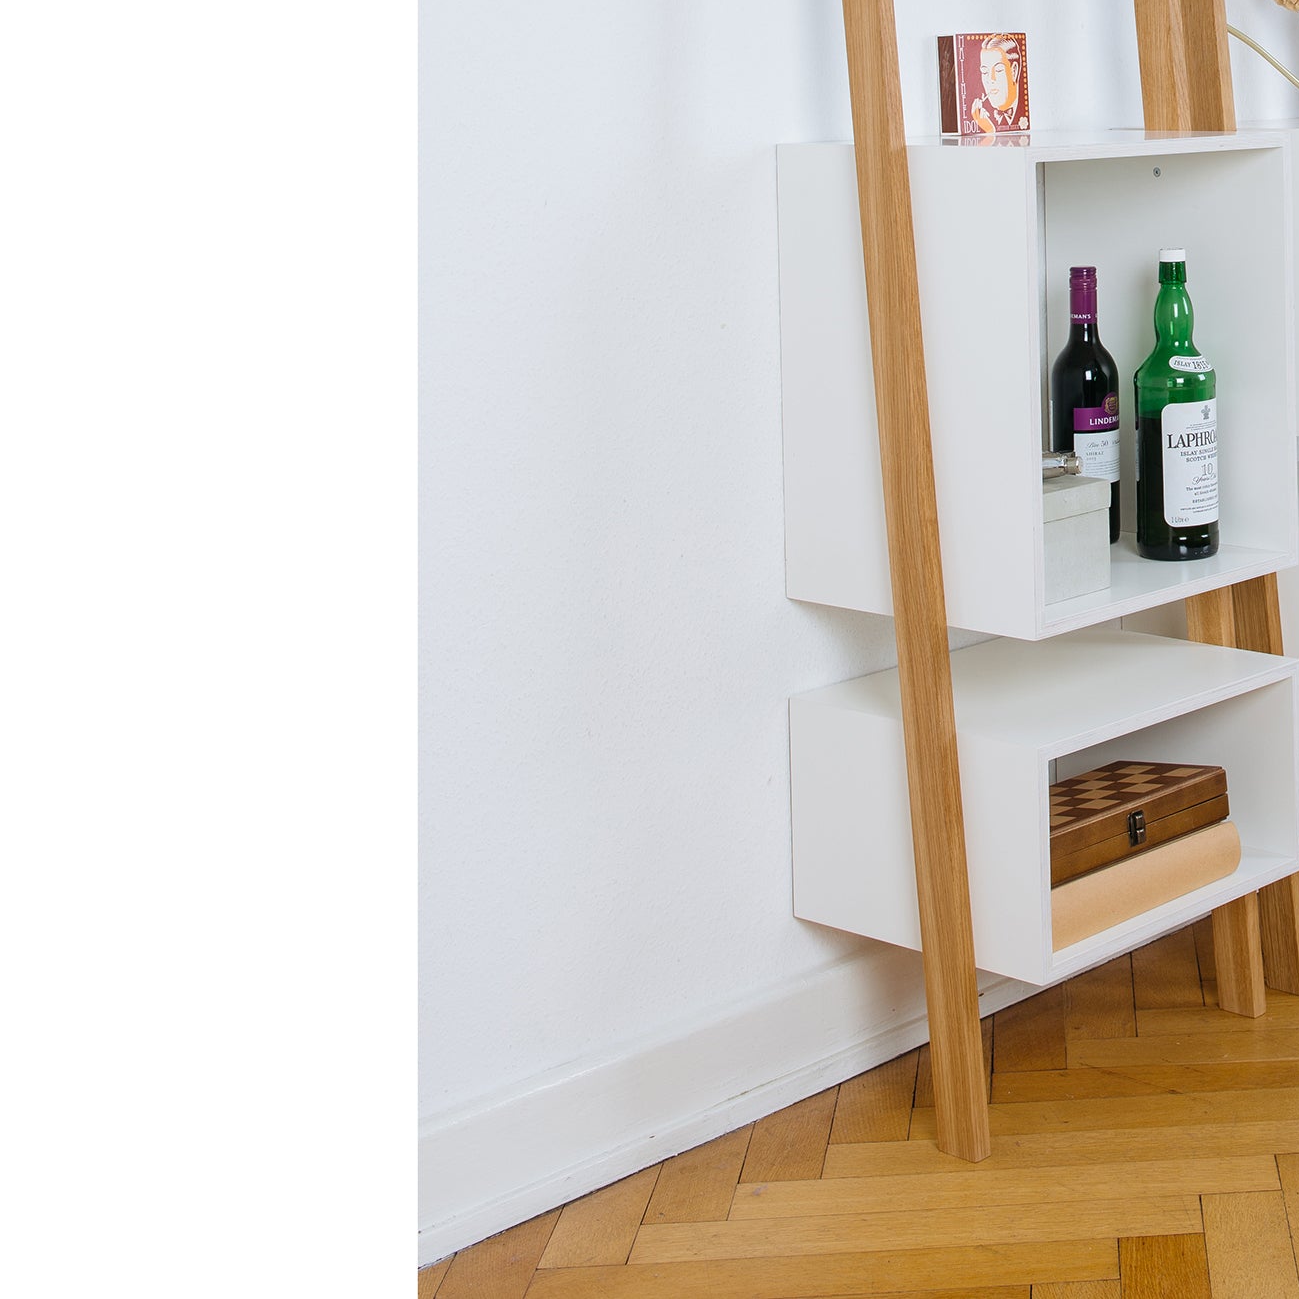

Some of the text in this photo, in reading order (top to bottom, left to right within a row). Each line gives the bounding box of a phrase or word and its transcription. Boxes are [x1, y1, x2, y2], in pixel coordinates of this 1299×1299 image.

[963, 120, 980, 134] IDOL
[1173, 359, 1191, 368] ISLAY
[1185, 455, 1207, 463] SCOTCH
[1201, 462, 1214, 477] 10
